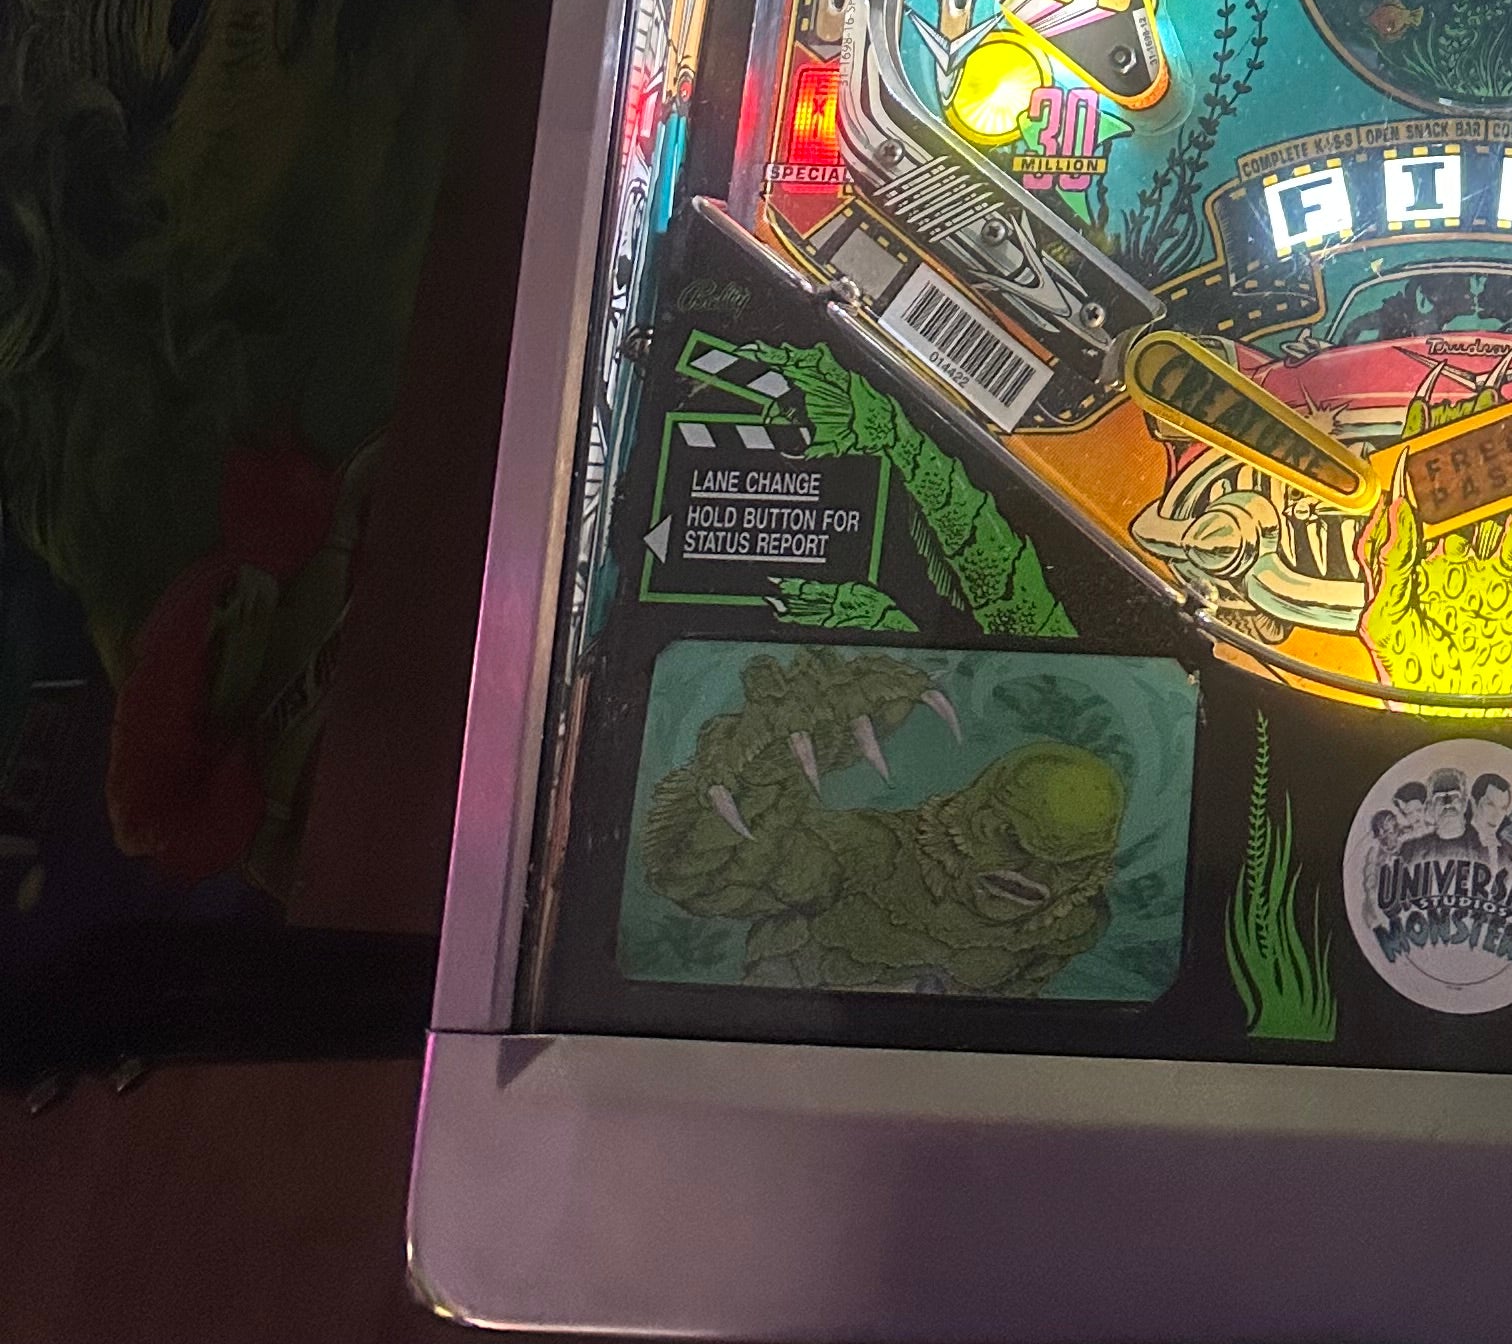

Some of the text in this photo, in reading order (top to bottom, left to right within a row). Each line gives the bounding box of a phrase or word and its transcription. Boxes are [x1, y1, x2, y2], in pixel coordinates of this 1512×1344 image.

[1021, 86, 1101, 192] 30
[1366, 120, 1482, 145] OPEN SNACK BAR
[1020, 157, 1100, 173] MILLION
[1241, 141, 1310, 178] COMPLETE
[769, 165, 855, 183] SPECIAL
[927, 350, 972, 390] 014422
[692, 469, 822, 496] LANE CHANGE
[686, 505, 860, 533] HOLD BUTTON FOR
[684, 532, 829, 557] STATUS REPORT
